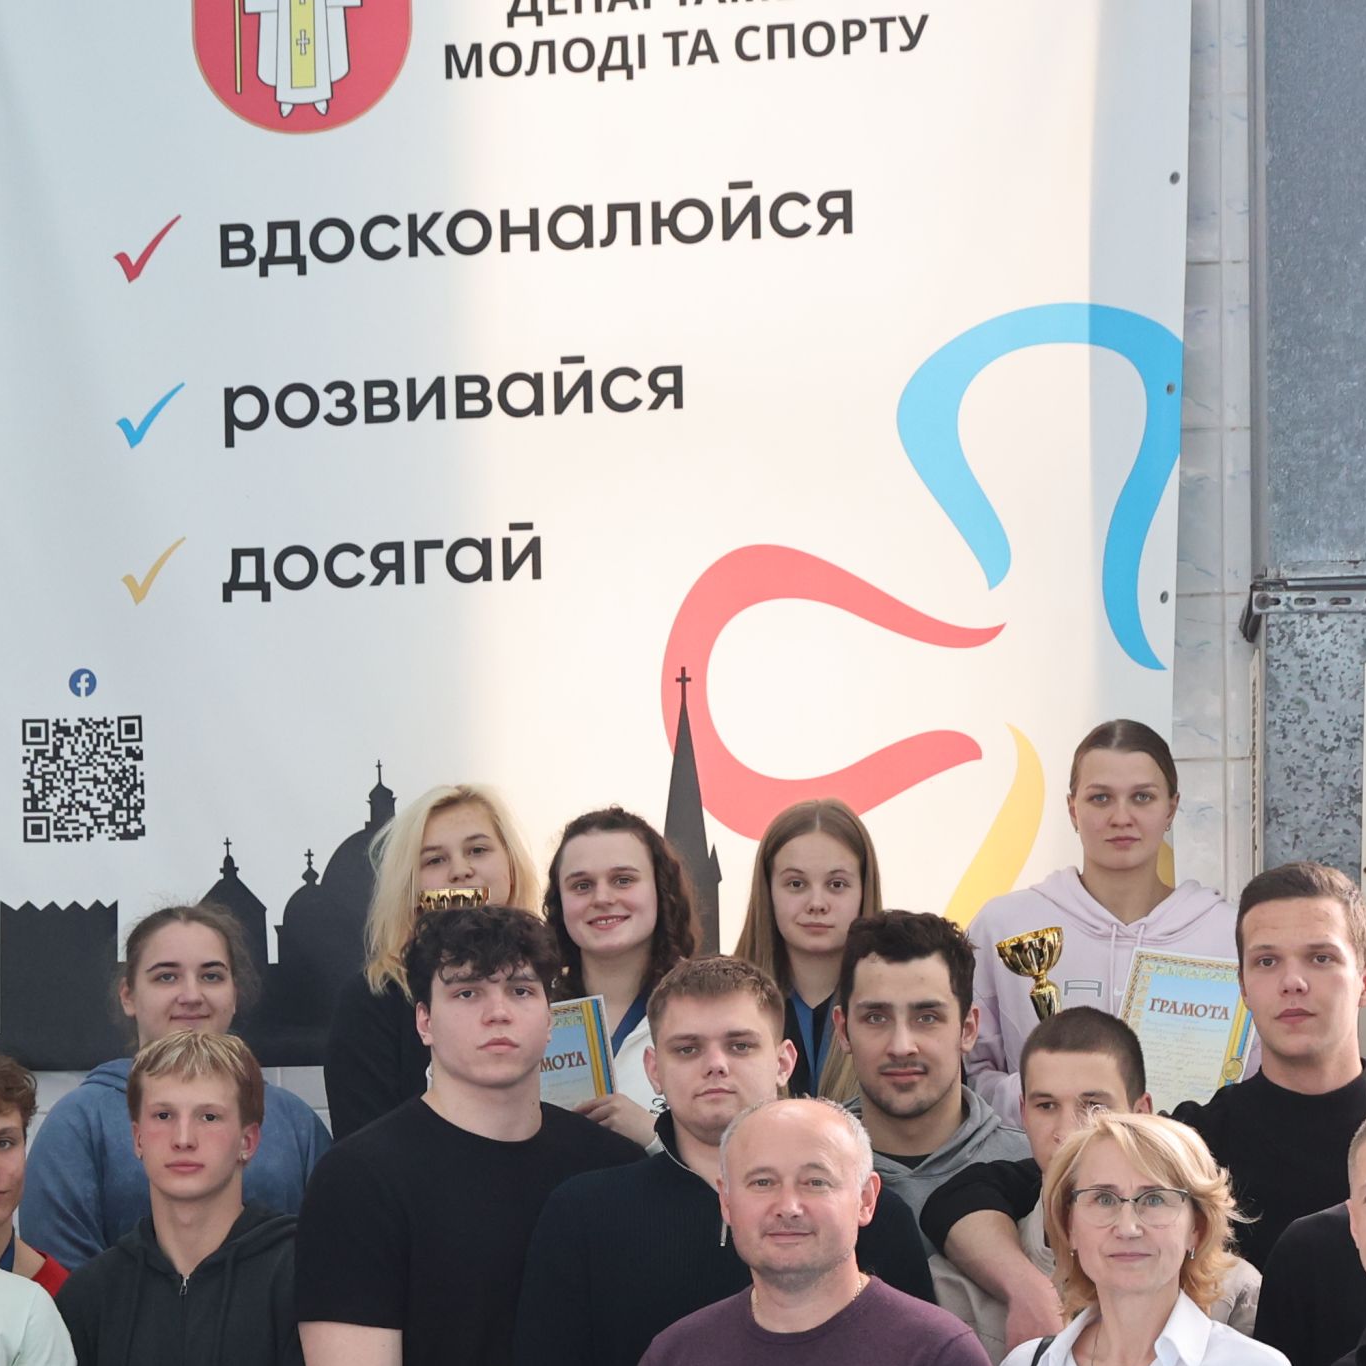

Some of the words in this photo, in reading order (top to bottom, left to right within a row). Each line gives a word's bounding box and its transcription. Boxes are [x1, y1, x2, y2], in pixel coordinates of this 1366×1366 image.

[444, 34, 646, 82] МОЛОДІ
[662, 29, 719, 67] ТА
[734, 14, 929, 62] СПОРТУ
[219, 181, 853, 278] вдосконалюйся
[223, 356, 684, 449] розвивайся
[222, 522, 542, 603] досягай
[1148, 998, 1231, 1021] ГРАМОТА
[540, 1051, 587, 1073] МОТА
